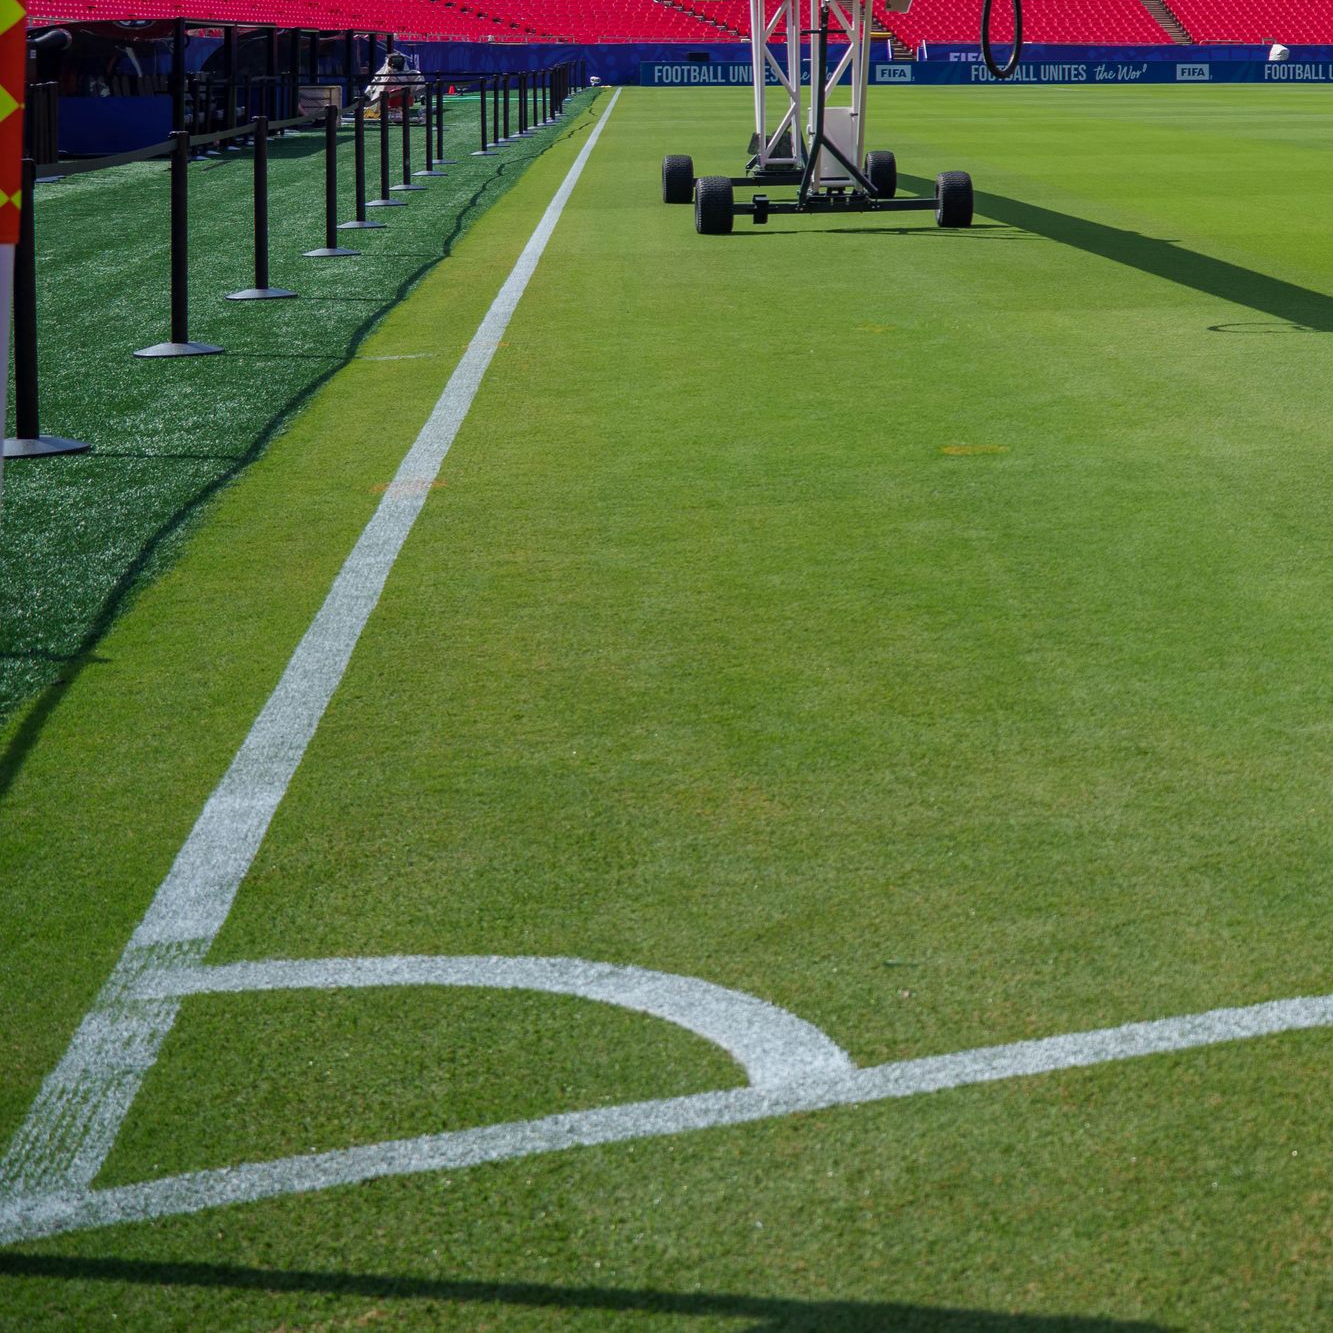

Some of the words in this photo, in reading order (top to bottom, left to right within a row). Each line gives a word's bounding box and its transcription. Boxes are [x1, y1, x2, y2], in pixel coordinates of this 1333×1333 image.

[654, 65, 726, 83] FOOTBALL
[729, 65, 779, 83] UNIES
[880, 68, 908, 79] FIFA
[1040, 64, 1087, 81] UNITES
[1093, 63, 1116, 81] the
[1180, 66, 1206, 78] FIFA
[1264, 64, 1326, 80] FOOTBALL
